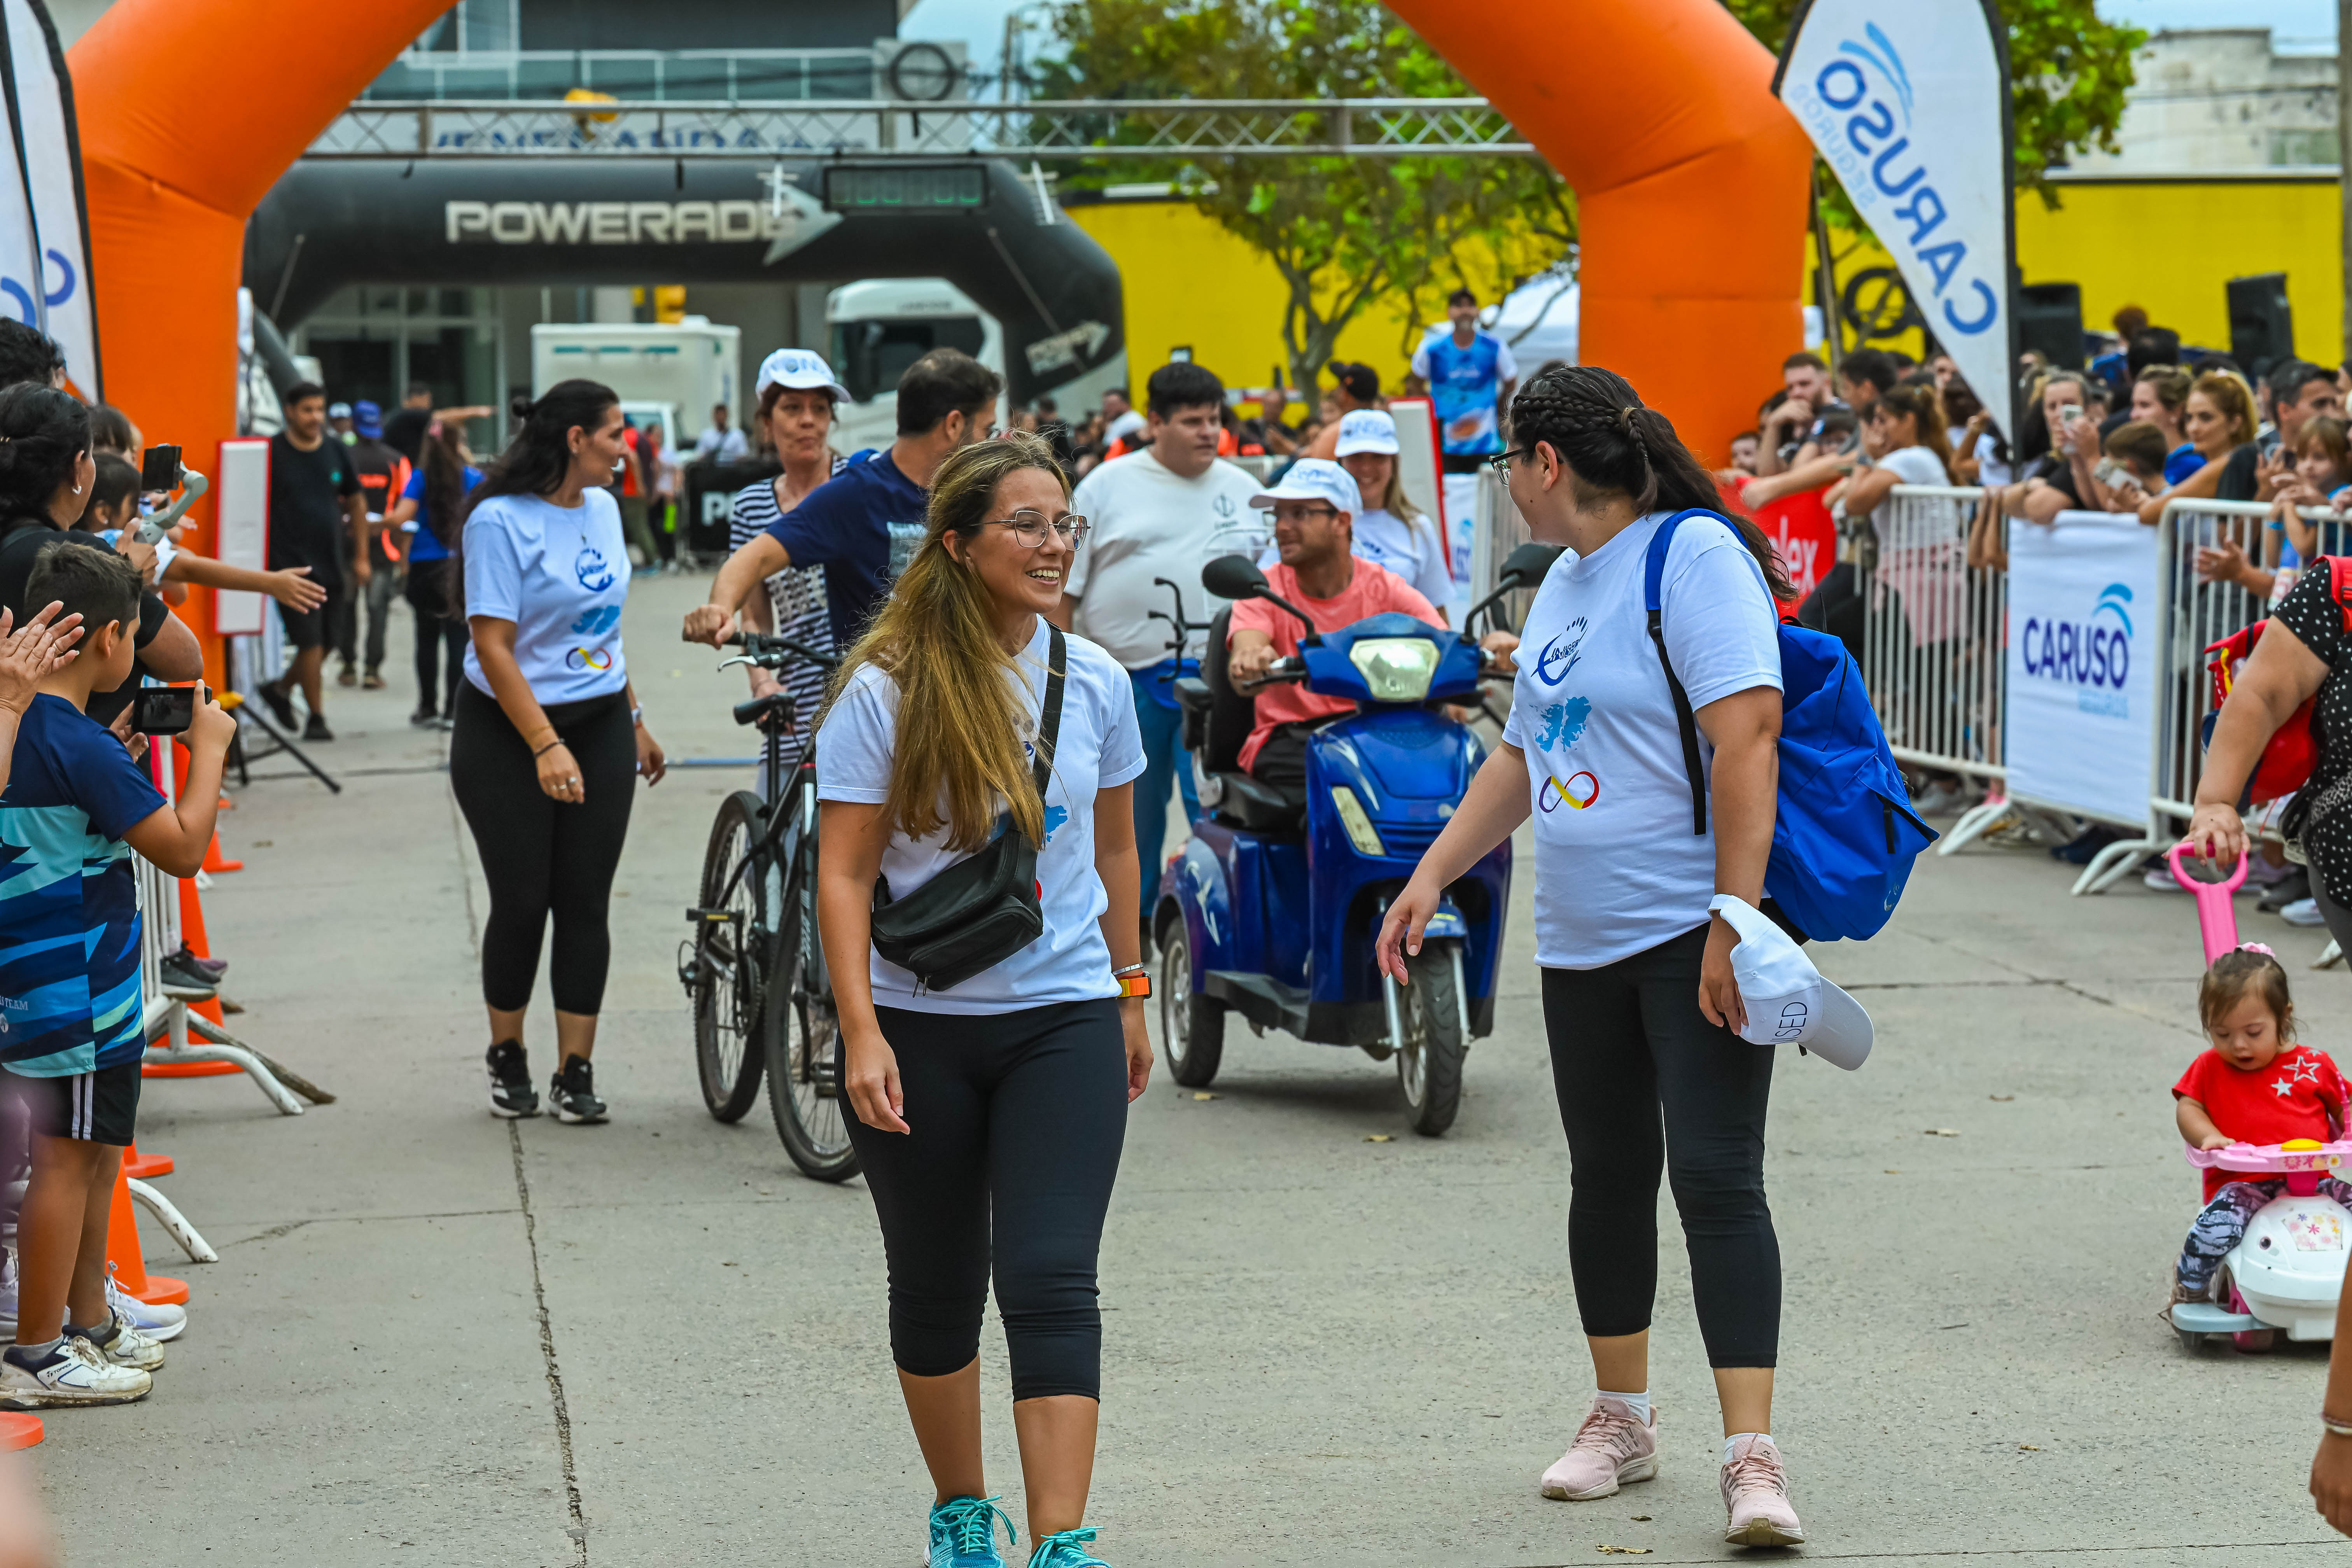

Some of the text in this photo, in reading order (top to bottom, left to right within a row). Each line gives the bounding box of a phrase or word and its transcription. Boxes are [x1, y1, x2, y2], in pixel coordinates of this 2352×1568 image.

[2023, 617, 2130, 690] CARUSO
[5, 998, 28, 1011] TEAM
[54, 1362, 72, 1374] TOPPER
